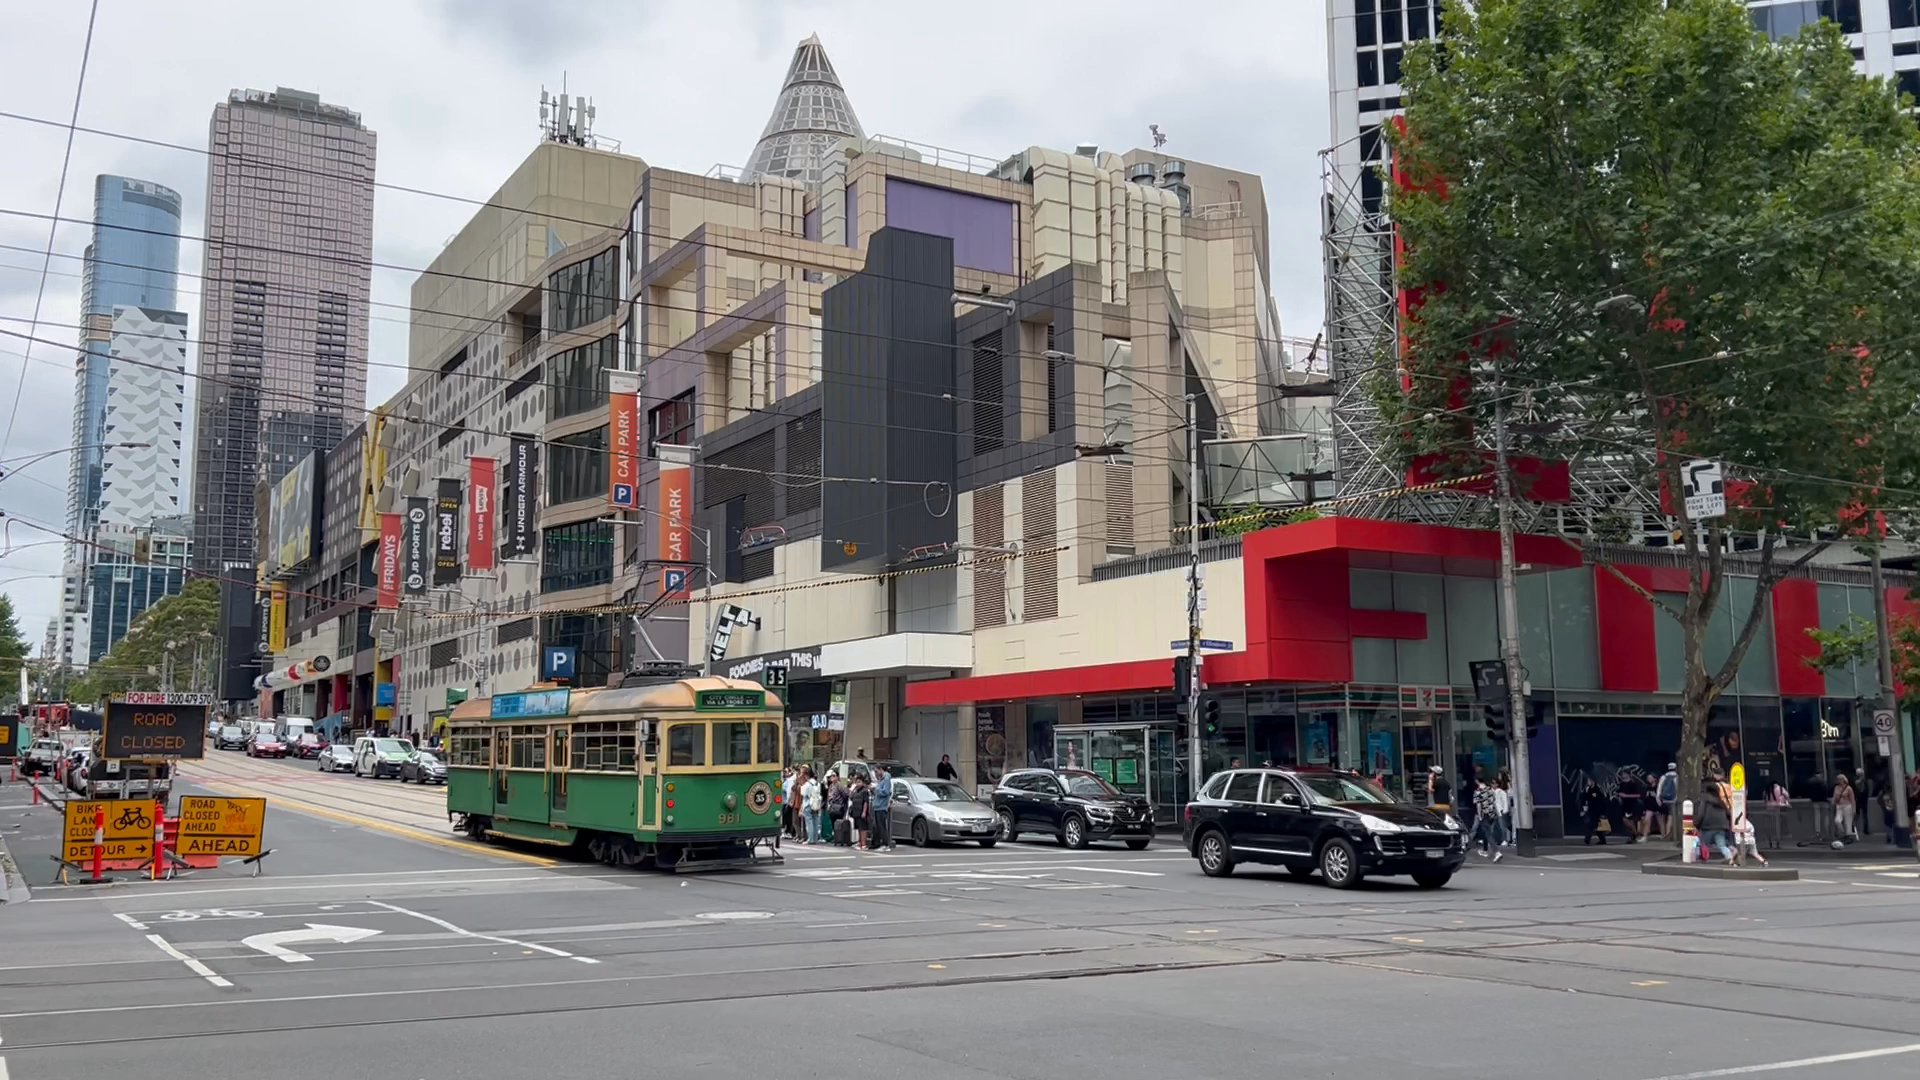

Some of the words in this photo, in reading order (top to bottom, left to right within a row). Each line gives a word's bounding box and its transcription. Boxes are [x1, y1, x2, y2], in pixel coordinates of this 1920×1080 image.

[618, 410, 629, 446] PARK
[518, 445, 527, 493] ARMOUR
[617, 450, 629, 477] CAR
[517, 495, 525, 533] UNDER
[669, 488, 681, 526] PARK
[439, 513, 453, 550] rebel
[412, 523, 420, 560] SPORTS
[669, 532, 681, 561] CAR
[384, 535, 396, 584] FRIDAYS
[411, 561, 419, 573] JD
[553, 652, 567, 671] P
[791, 652, 812, 668] THIS
[769, 669, 785, 685] 35
[128, 692, 146, 704] FOR
[147, 693, 165, 704] HIRE
[167, 693, 184, 704] 1300
[186, 694, 198, 704] 479
[199, 694, 212, 704] 570
[134, 713, 176, 726] ROAD
[1877, 717, 1891, 727] 40
[121, 736, 186, 748] CLOSED
[190, 800, 216, 809] ROAD
[73, 816, 96, 825] LAN
[184, 811, 220, 820] CLOSED
[719, 813, 742, 825] 981
[185, 822, 216, 831] AHEAD
[188, 839, 249, 852] AHEAD
